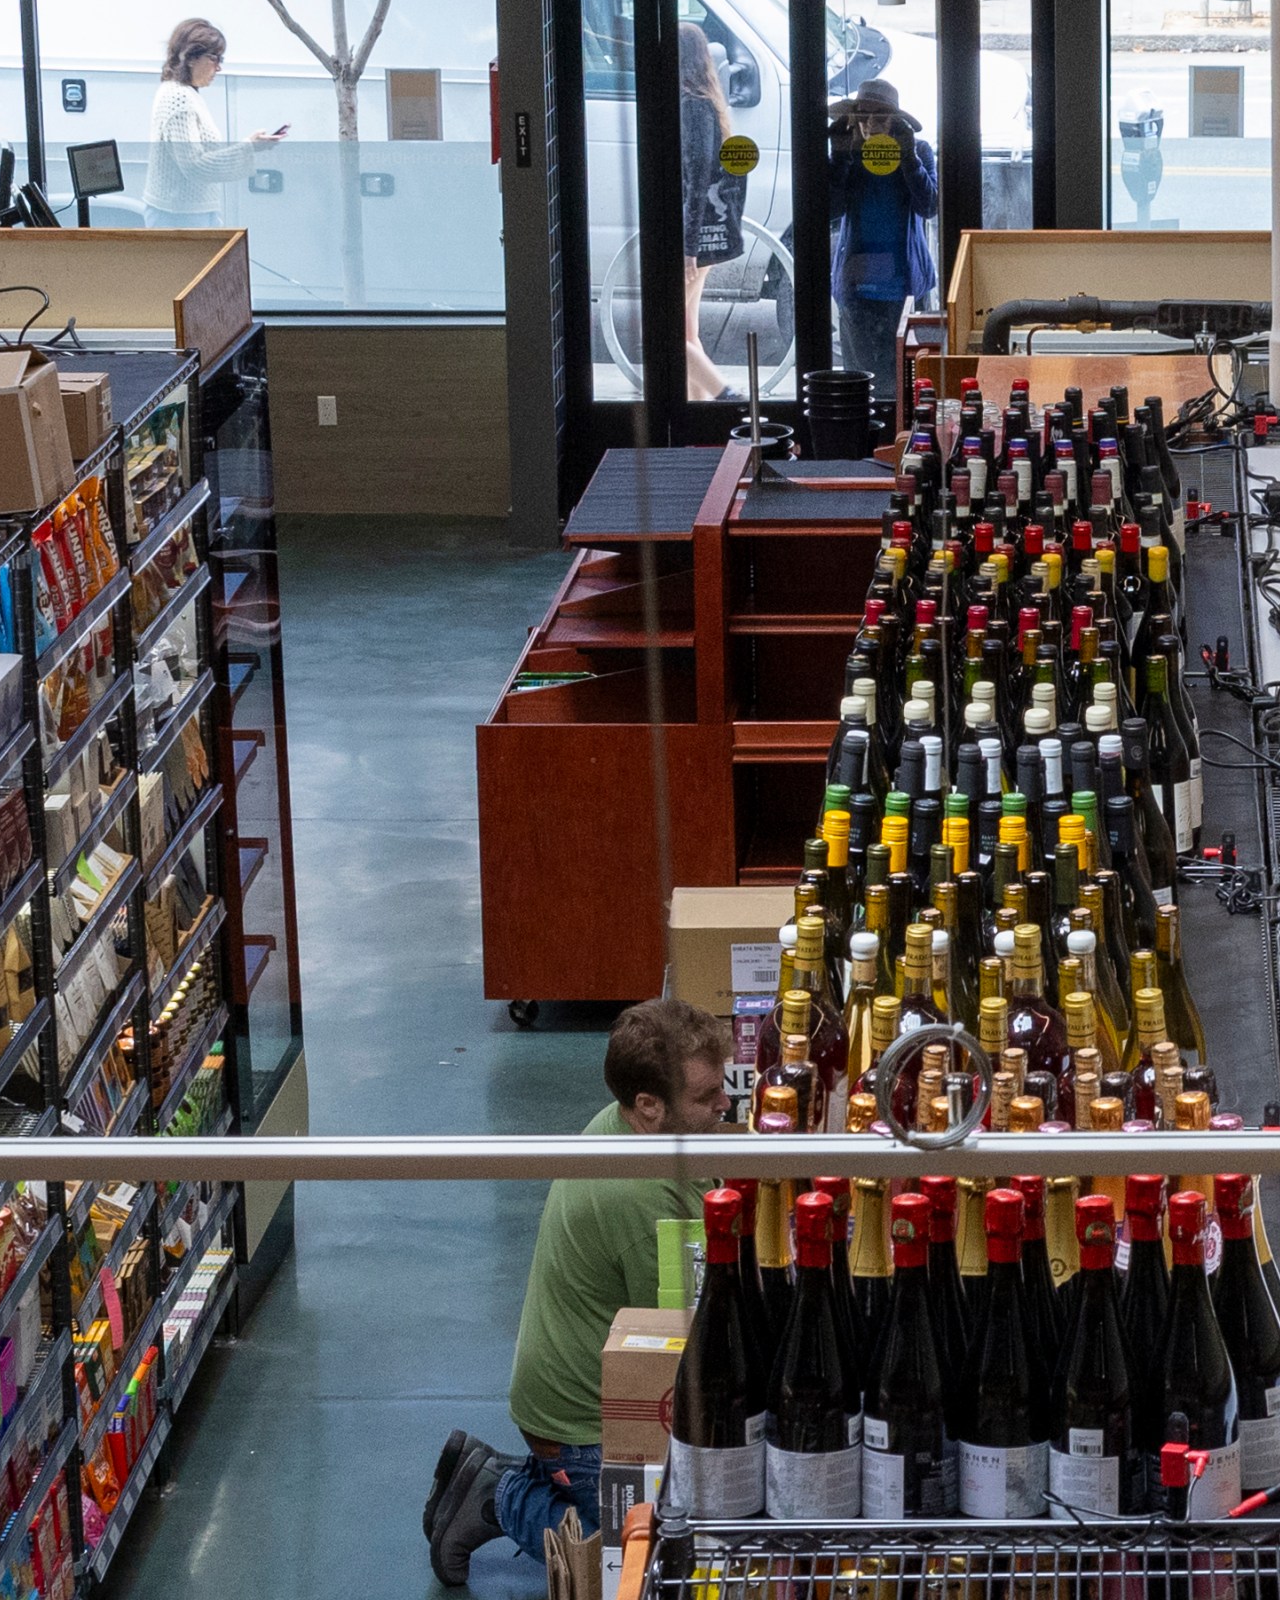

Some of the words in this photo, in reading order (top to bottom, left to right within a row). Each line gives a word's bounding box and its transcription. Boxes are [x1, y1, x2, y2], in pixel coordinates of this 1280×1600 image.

[518, 116, 527, 157] EXIT
[720, 151, 759, 161] CAUTION
[862, 151, 902, 160] CAUTION
[871, 160, 892, 168] DOOR
